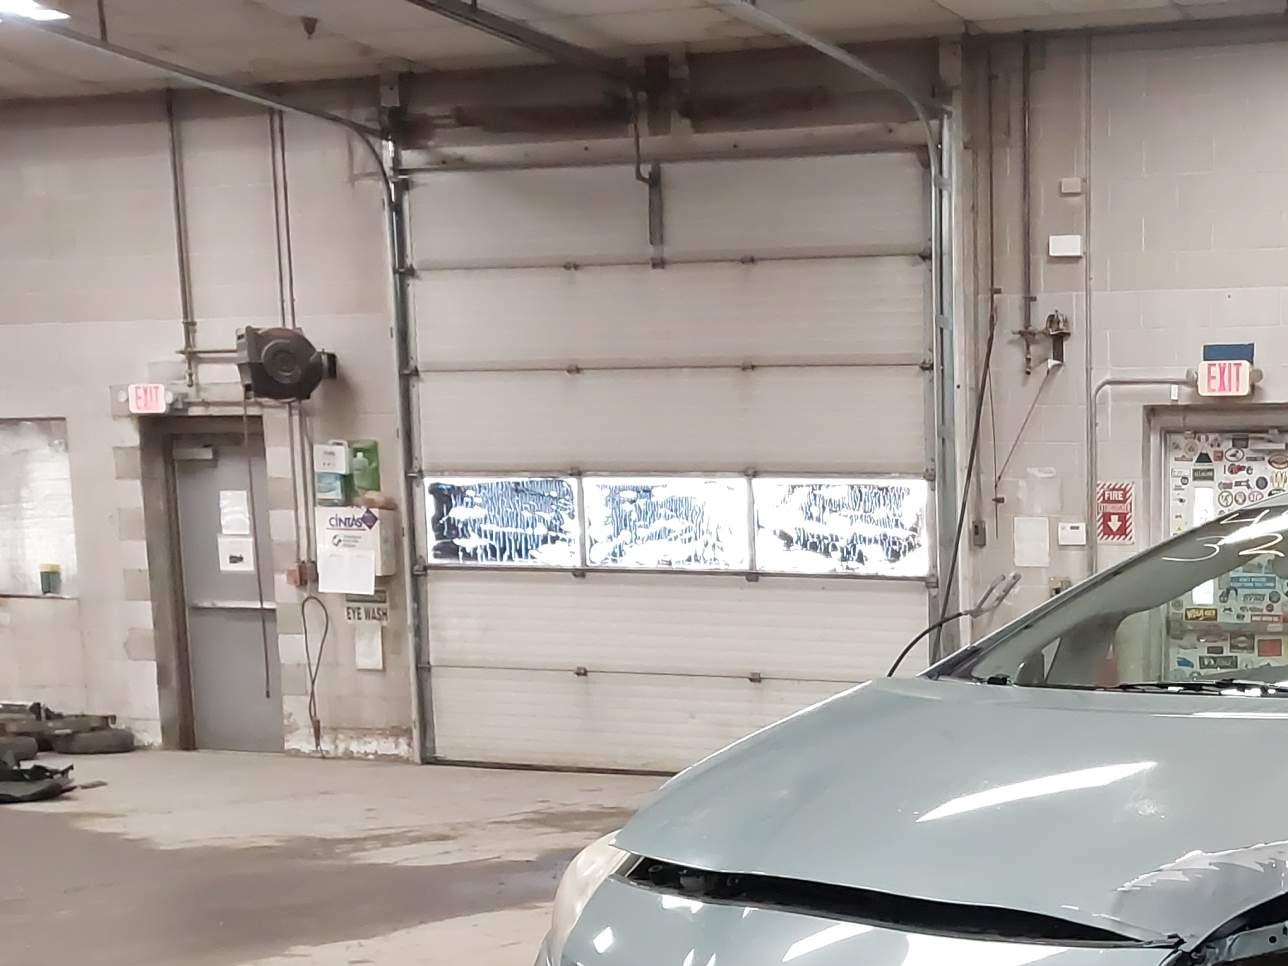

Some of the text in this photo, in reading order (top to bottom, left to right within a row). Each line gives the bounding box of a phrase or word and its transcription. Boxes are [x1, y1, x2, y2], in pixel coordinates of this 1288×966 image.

[1207, 362, 1242, 393] EXIT
[135, 386, 160, 410] EXIT
[1104, 490, 1124, 501] FIRE
[346, 606, 389, 621] EYE WASH
